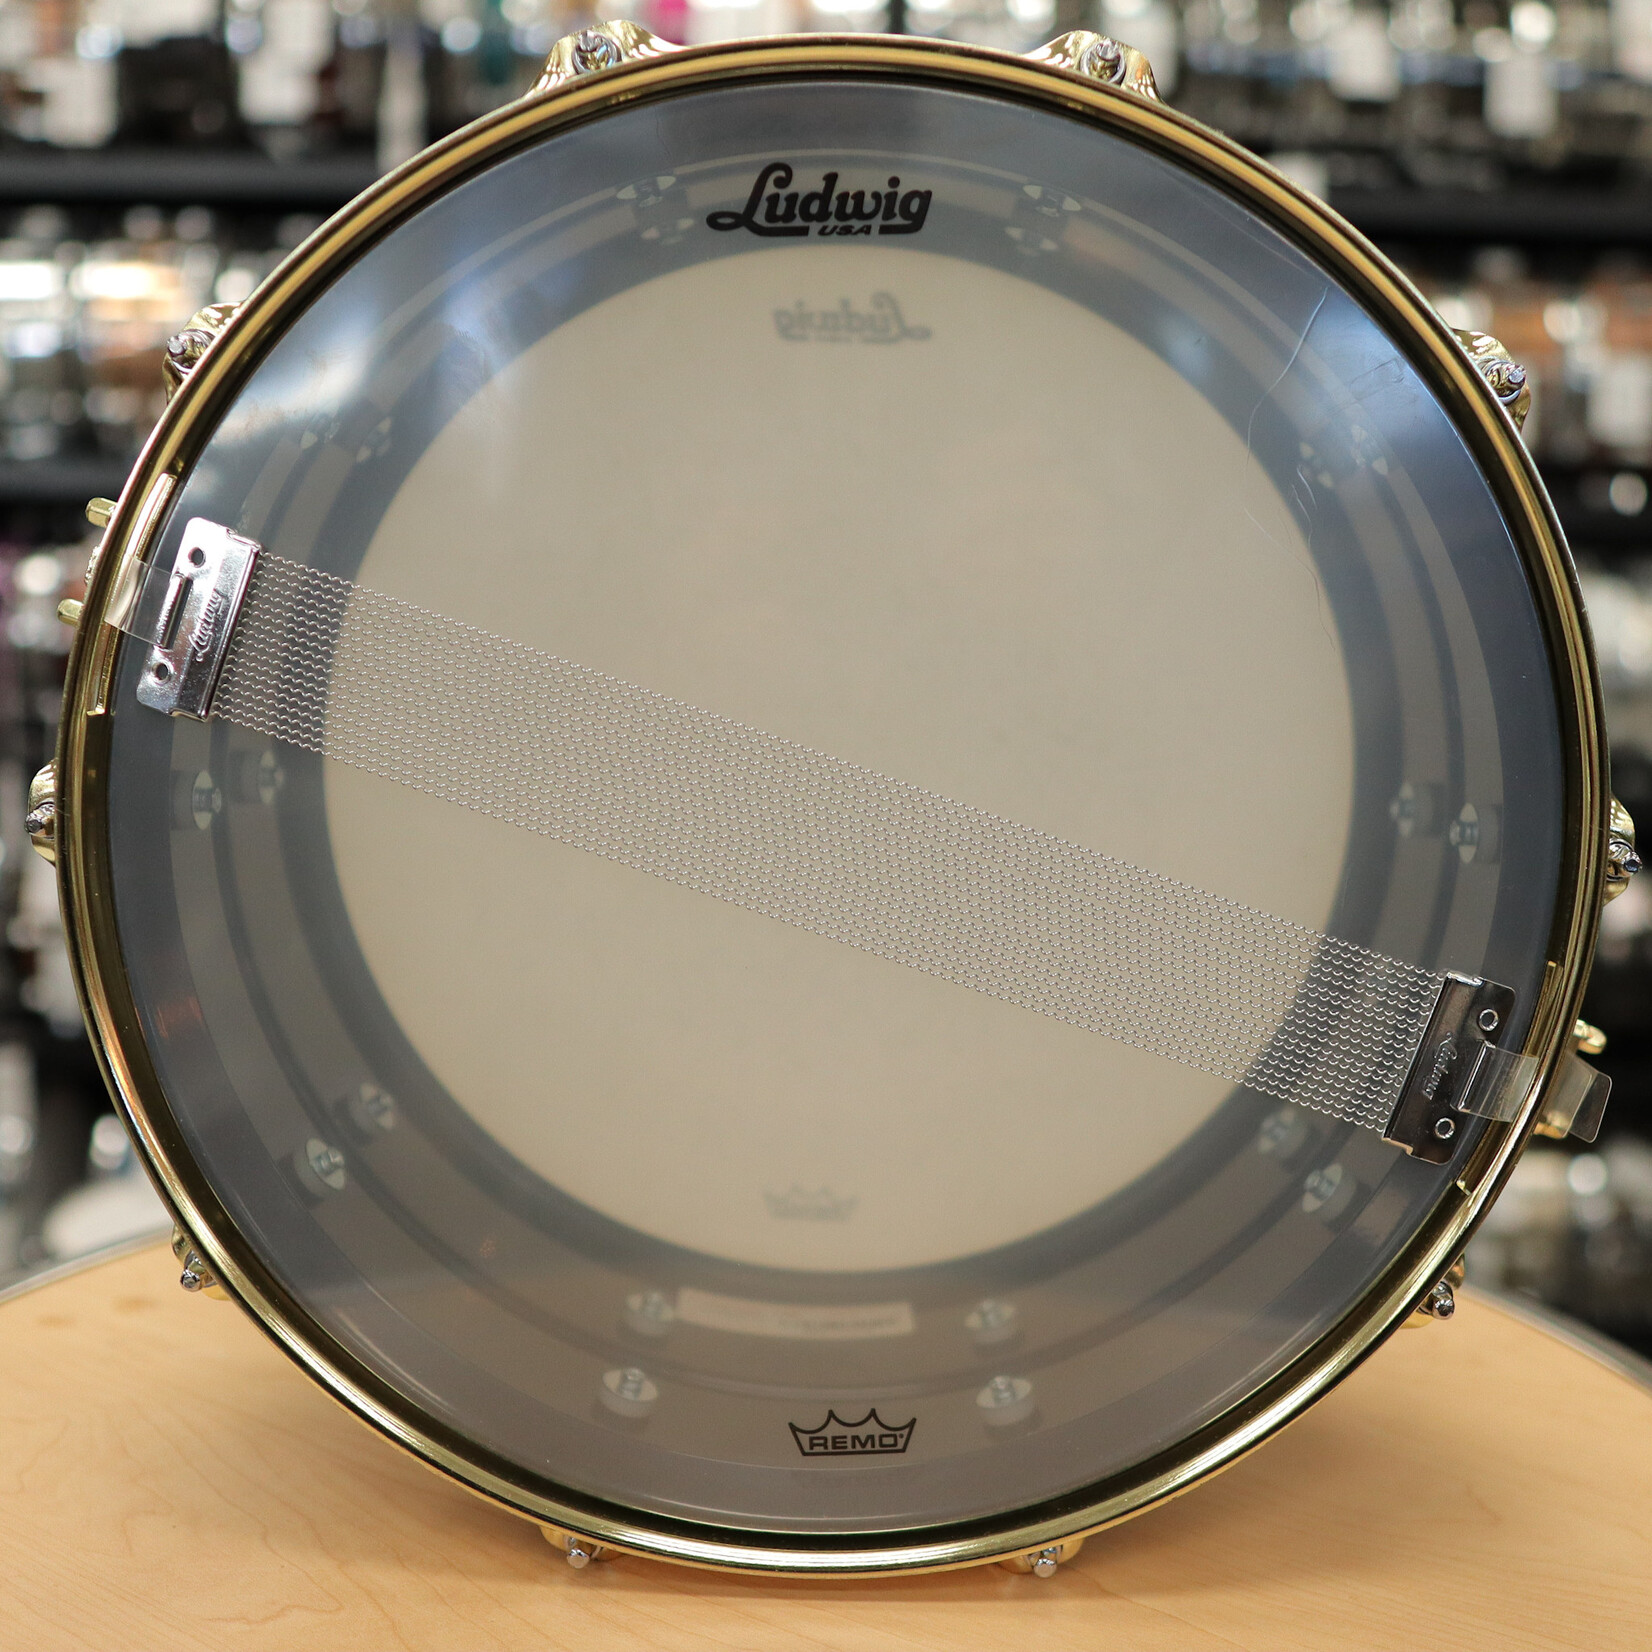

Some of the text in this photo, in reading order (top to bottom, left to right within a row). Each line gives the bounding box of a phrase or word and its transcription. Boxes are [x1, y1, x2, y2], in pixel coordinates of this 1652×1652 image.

[706, 162, 932, 237] Ludwig
[818, 224, 872, 236] USA
[808, 1433, 899, 1451] REMO
